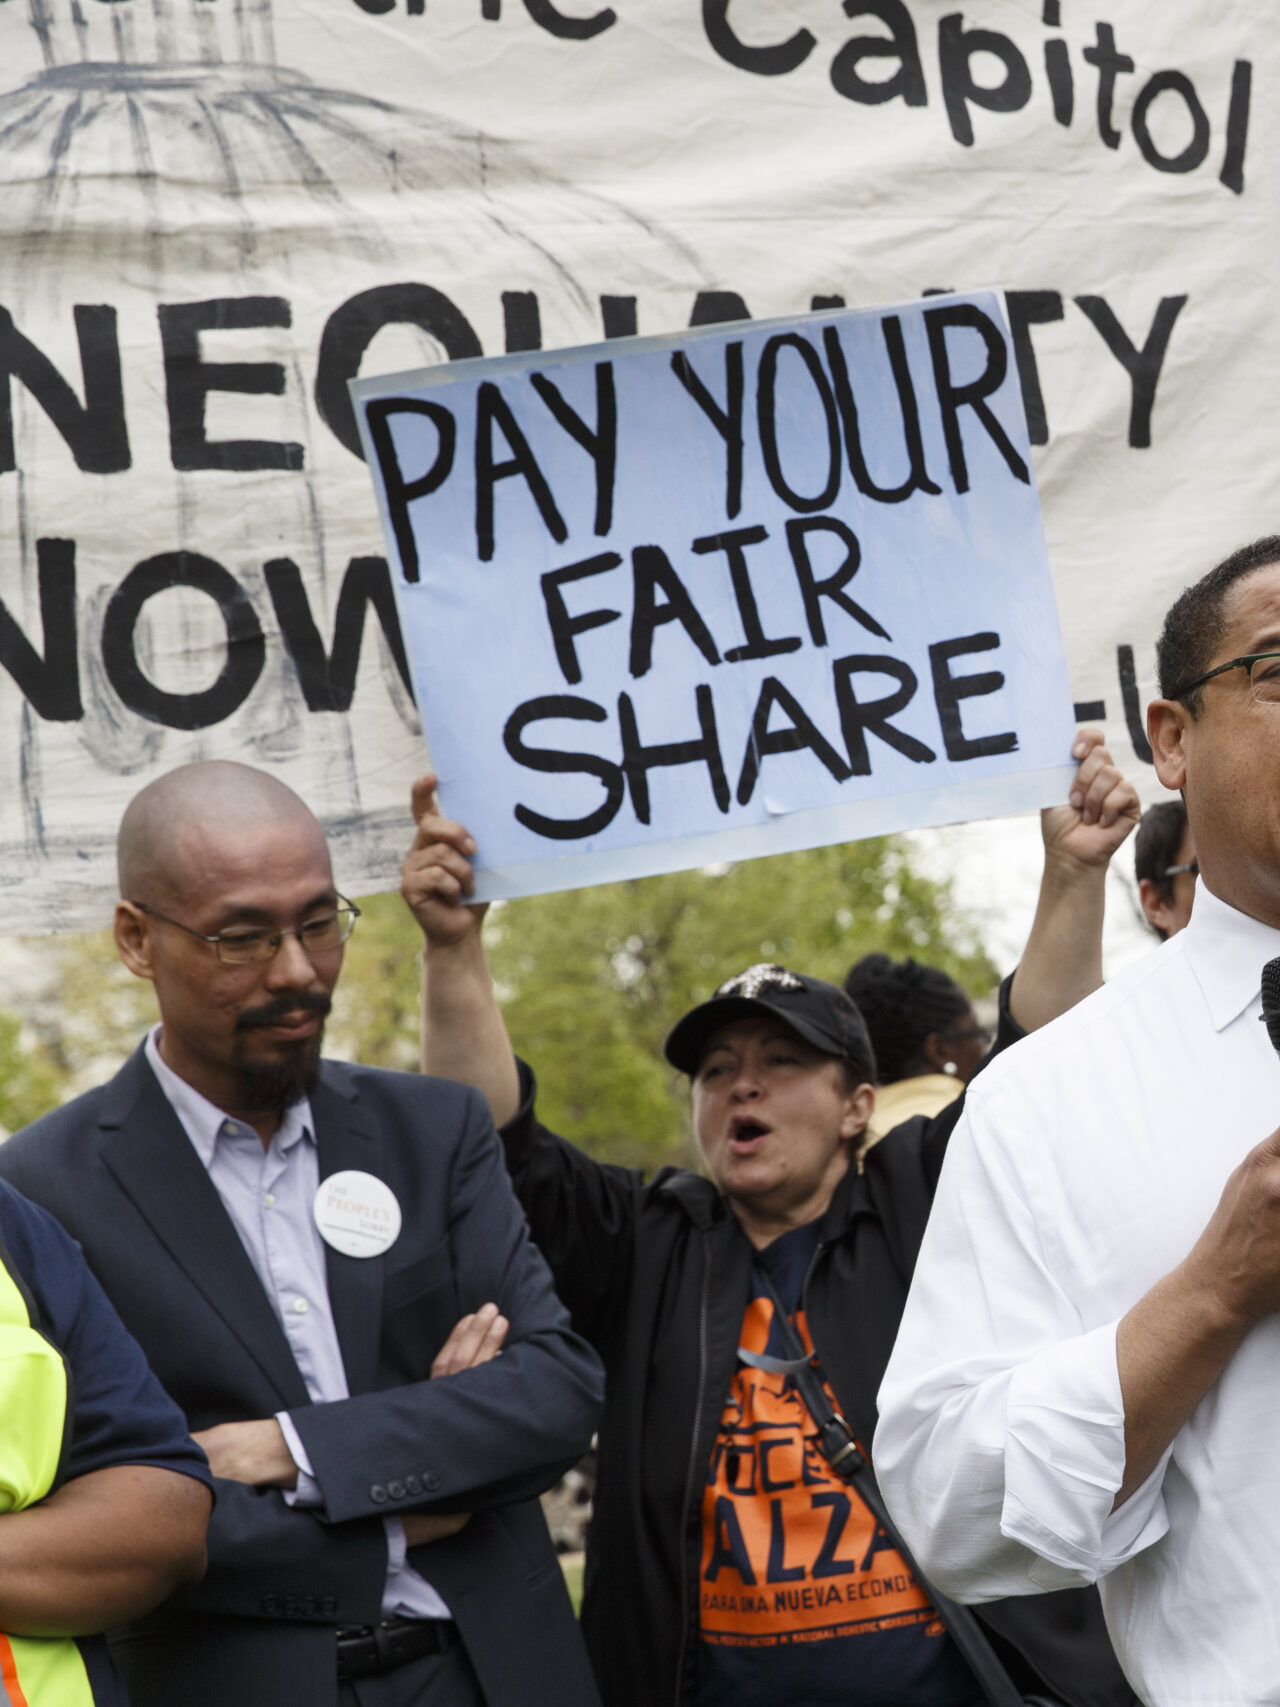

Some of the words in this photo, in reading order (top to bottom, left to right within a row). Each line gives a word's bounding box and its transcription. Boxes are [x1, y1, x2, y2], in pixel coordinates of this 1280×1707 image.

[365, 361, 618, 583] PAY
[671, 303, 1031, 520] YOUR
[540, 515, 893, 686] FAIR
[502, 631, 1020, 841] SHARE
[774, 1584, 843, 1613] NUEVA
